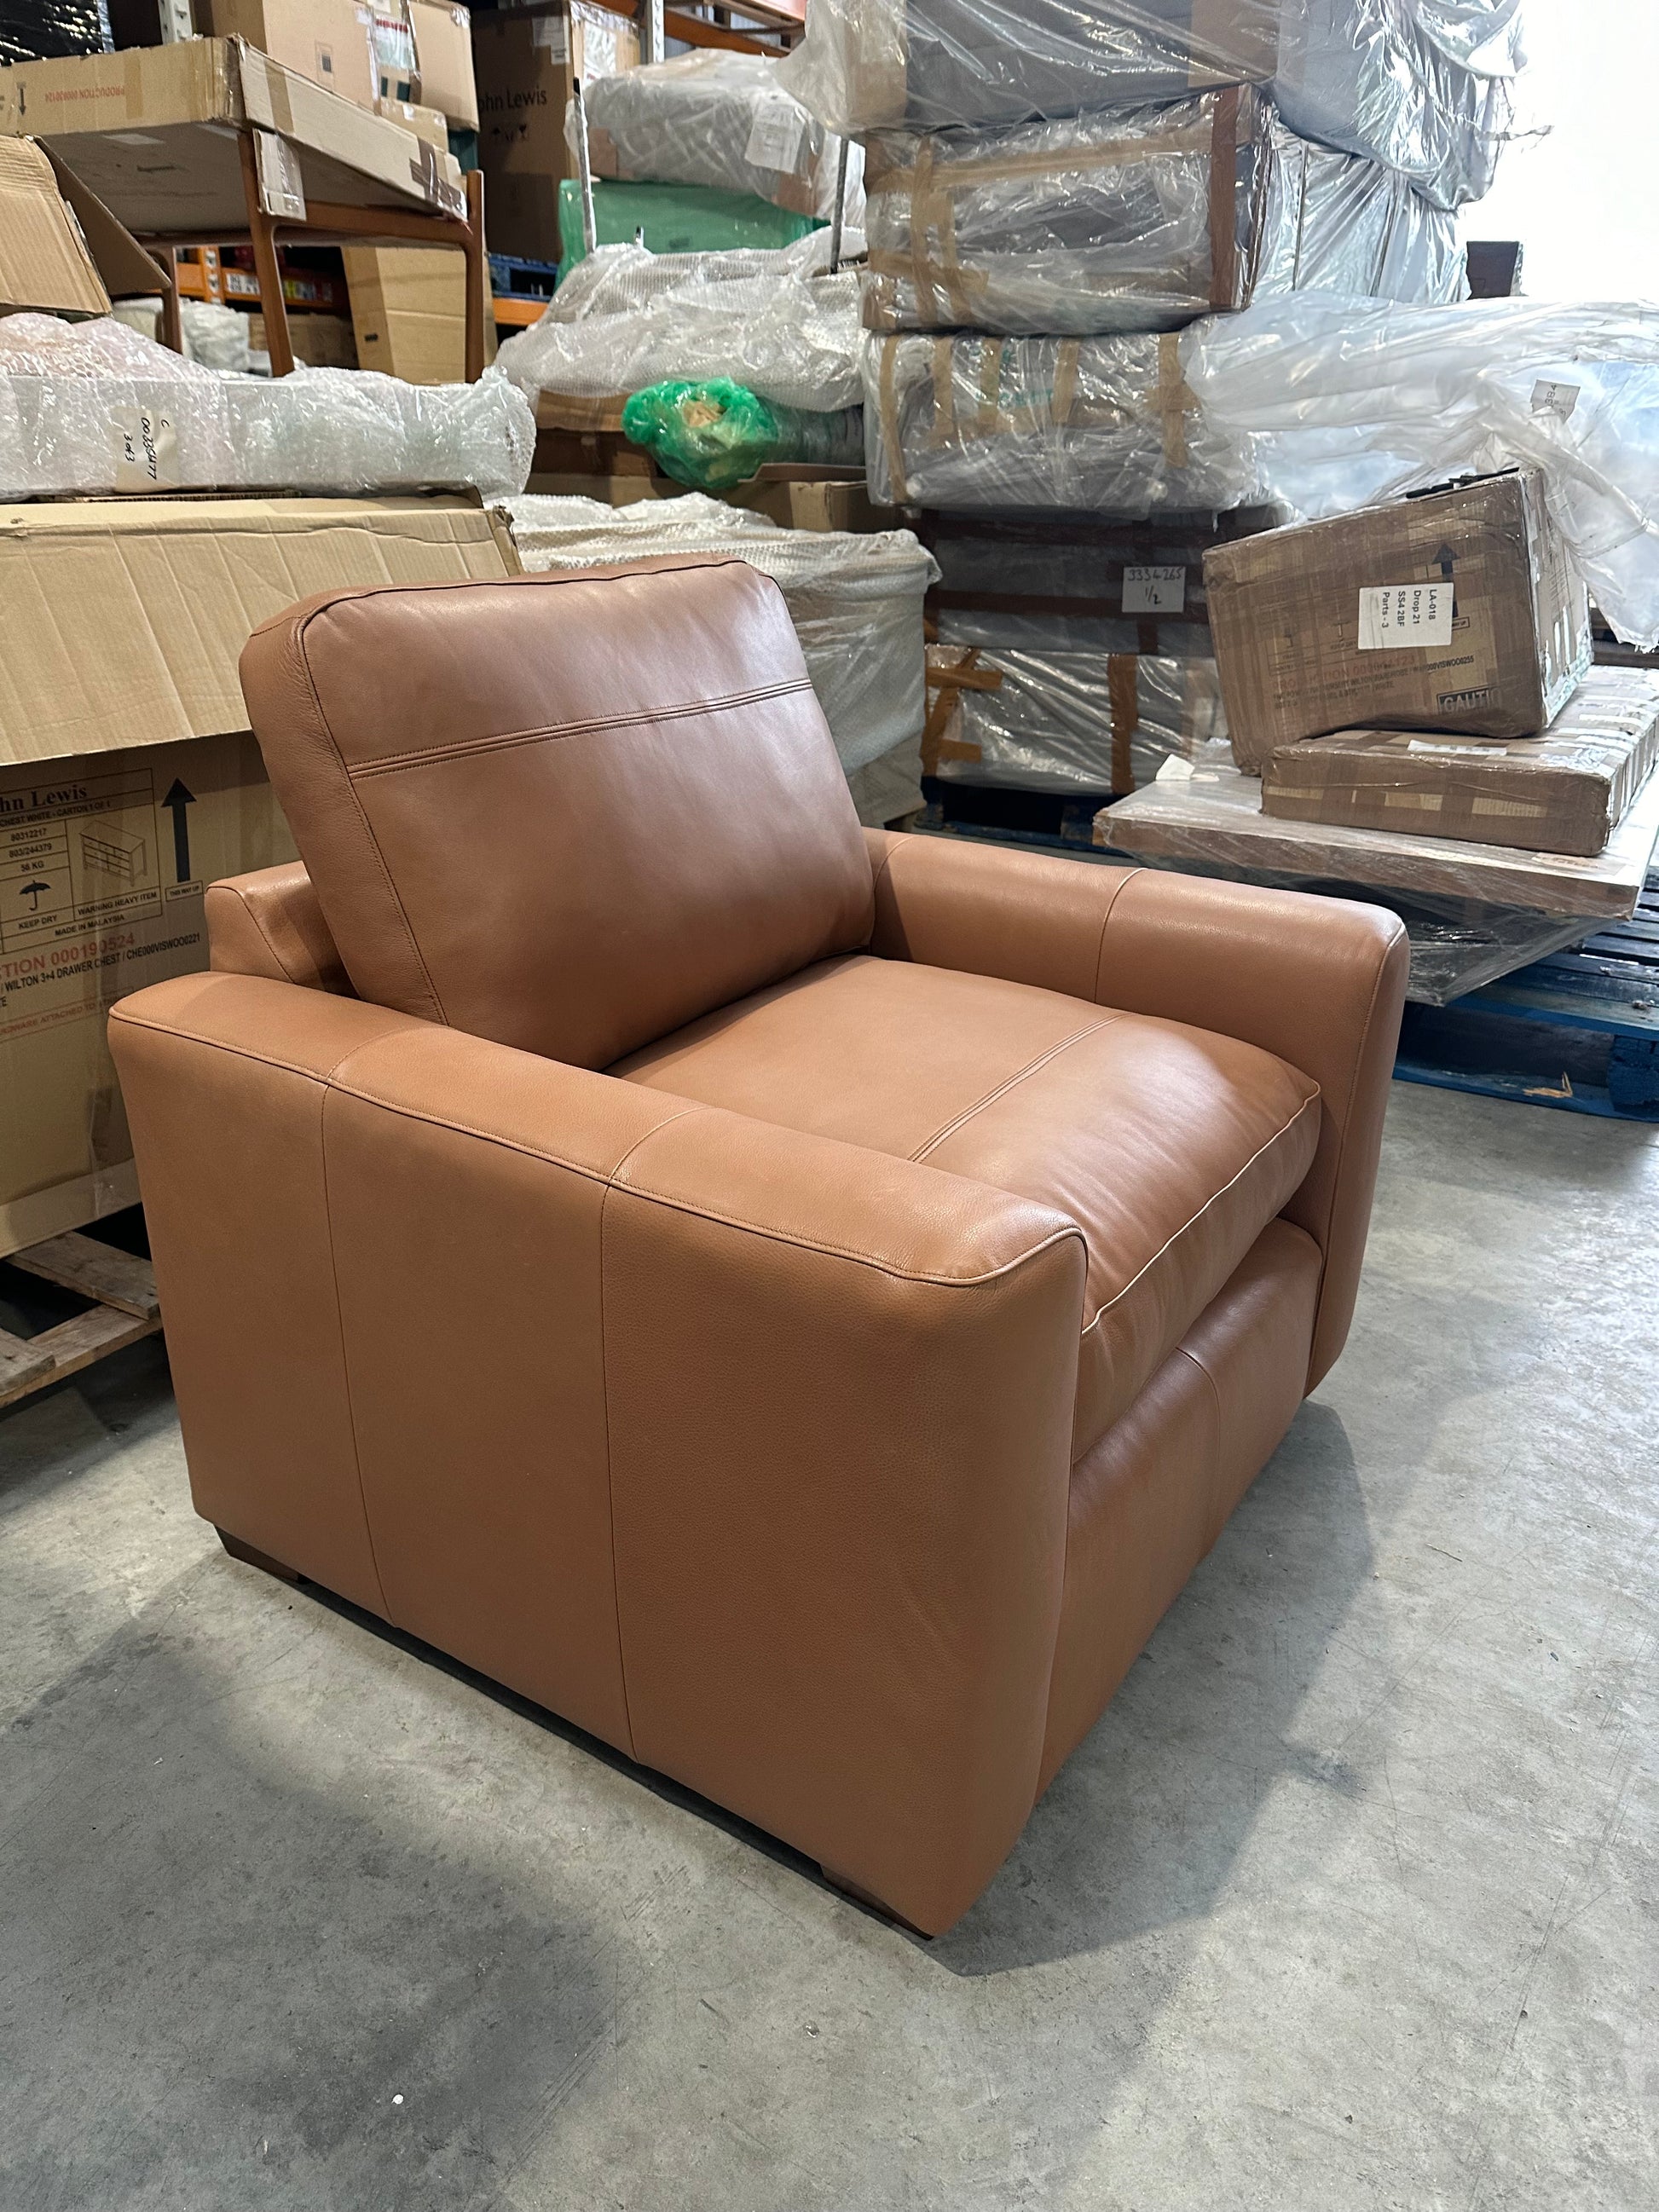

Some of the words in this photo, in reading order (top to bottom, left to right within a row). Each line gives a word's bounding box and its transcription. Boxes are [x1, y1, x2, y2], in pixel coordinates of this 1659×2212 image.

[478, 91, 504, 112] ohn
[506, 85, 547, 108] Lewis
[124, 433, 133, 442] 3
[124, 453, 135, 462] 3
[1382, 592, 1390, 615] Parts
[1397, 591, 1406, 609] SS4
[1412, 590, 1421, 612] Drop
[1428, 588, 1437, 621] LA-018
[1396, 609, 1405, 627] 2BF
[1413, 614, 1420, 625] 21
[31, 784, 88, 806] Lewis
[32, 860, 44, 870] KG
[78, 901, 113, 915] WARNING
[114, 895, 138, 908] HEAVY
[140, 892, 158, 901] ITEM
[19, 919, 39, 929] KEEP
[41, 915, 57, 925] DRY
[55, 926, 76, 937] MADE
[88, 914, 125, 927] MALAYSIA
[0, 955, 45, 978] TION
[51, 932, 135, 966] 000190524
[4, 974, 39, 992] WILTON
[41, 970, 55, 983] 3+4
[56, 960, 94, 979] DRAWER
[94, 952, 120, 968] CHEST
